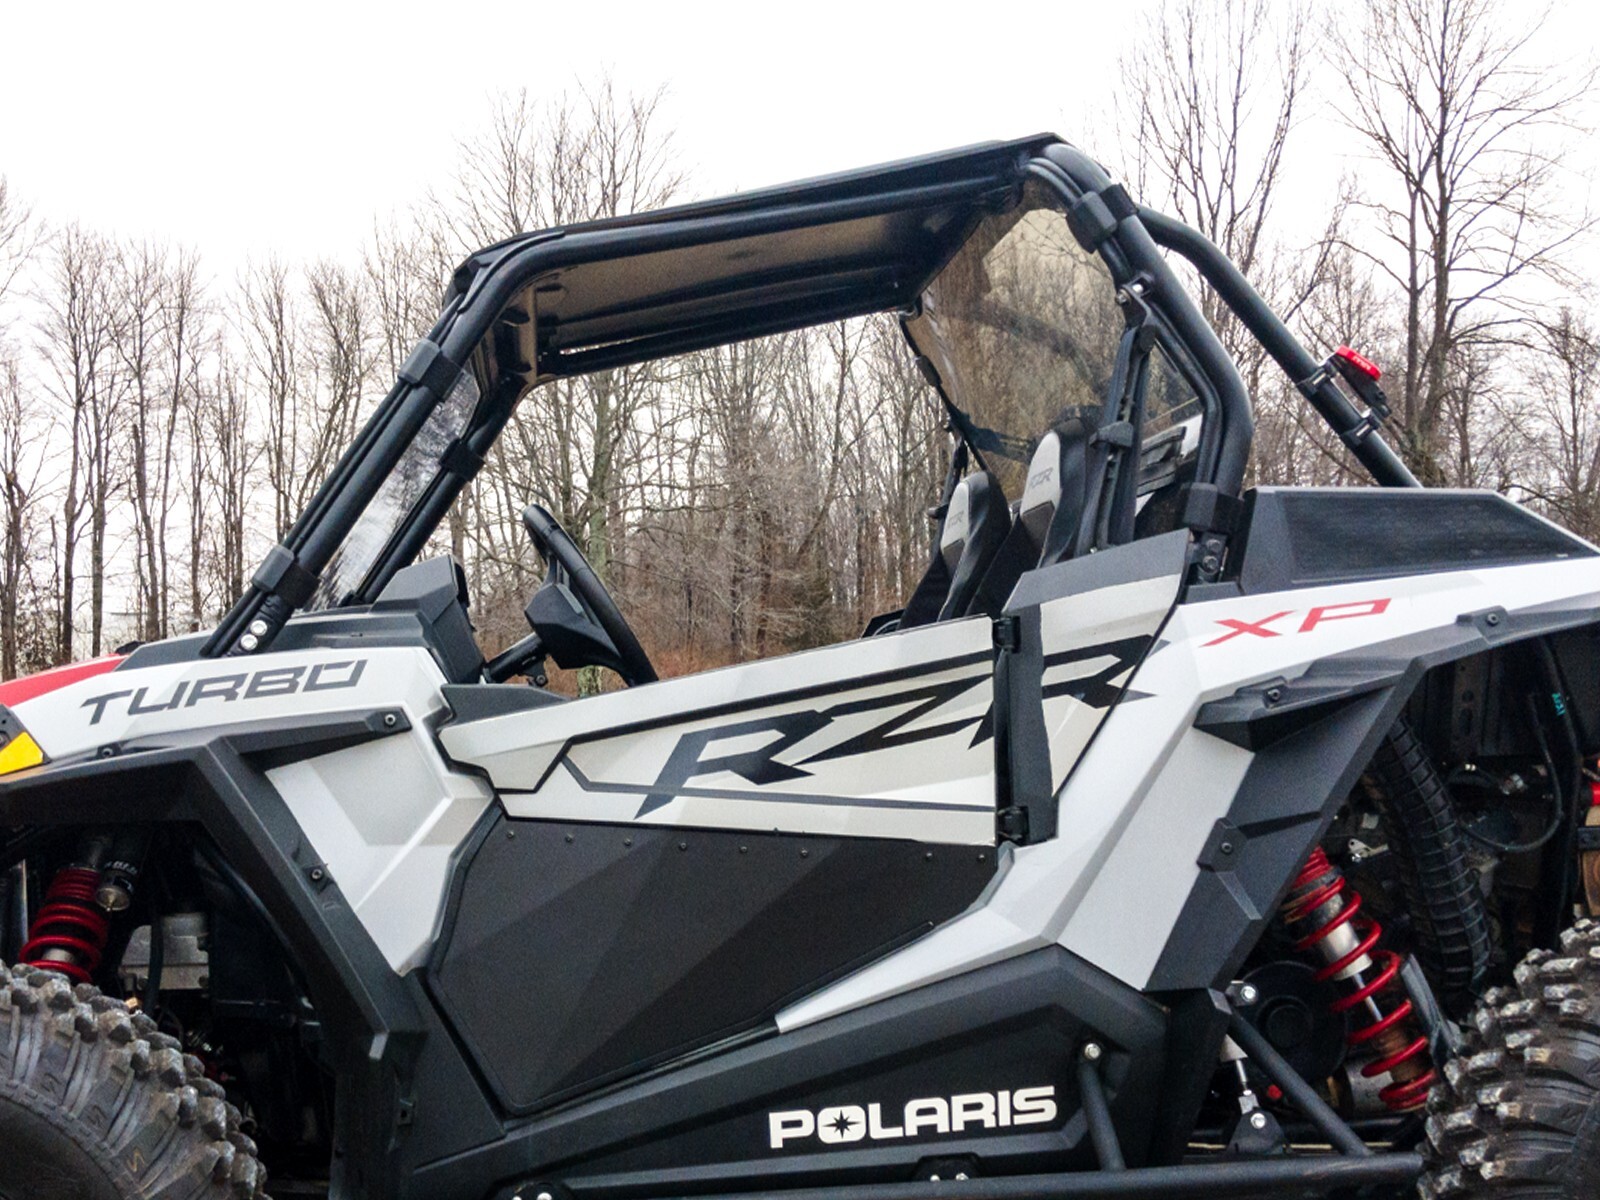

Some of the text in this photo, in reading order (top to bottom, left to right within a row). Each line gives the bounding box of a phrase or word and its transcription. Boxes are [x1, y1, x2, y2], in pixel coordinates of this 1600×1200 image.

[1199, 598, 1393, 648] XP
[80, 659, 369, 726] TURBO
[634, 634, 1172, 820] RZR
[768, 1085, 1058, 1149] POLARIS
